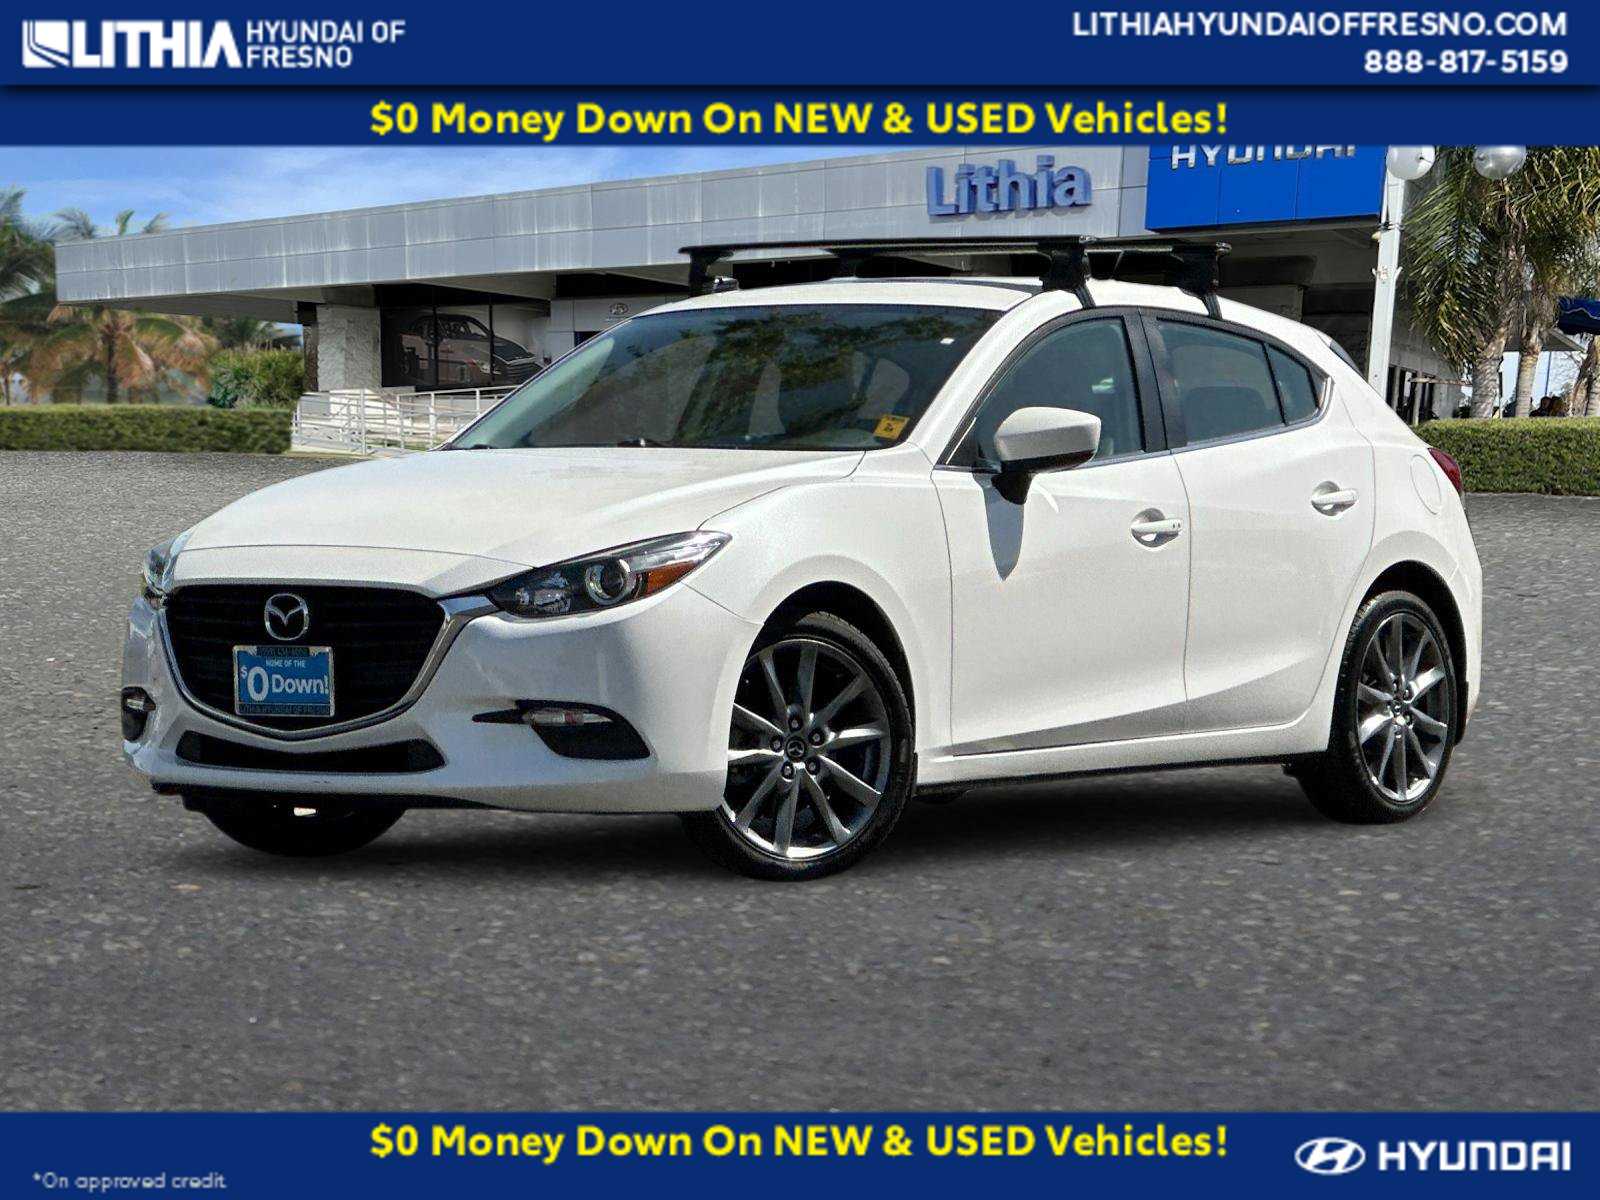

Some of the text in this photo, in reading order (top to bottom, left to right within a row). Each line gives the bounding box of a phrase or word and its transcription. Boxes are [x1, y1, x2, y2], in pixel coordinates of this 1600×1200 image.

[926, 155, 1091, 216] Lithia
[265, 659, 306, 669] HOME OF THE
[271, 674, 330, 695] Down!
